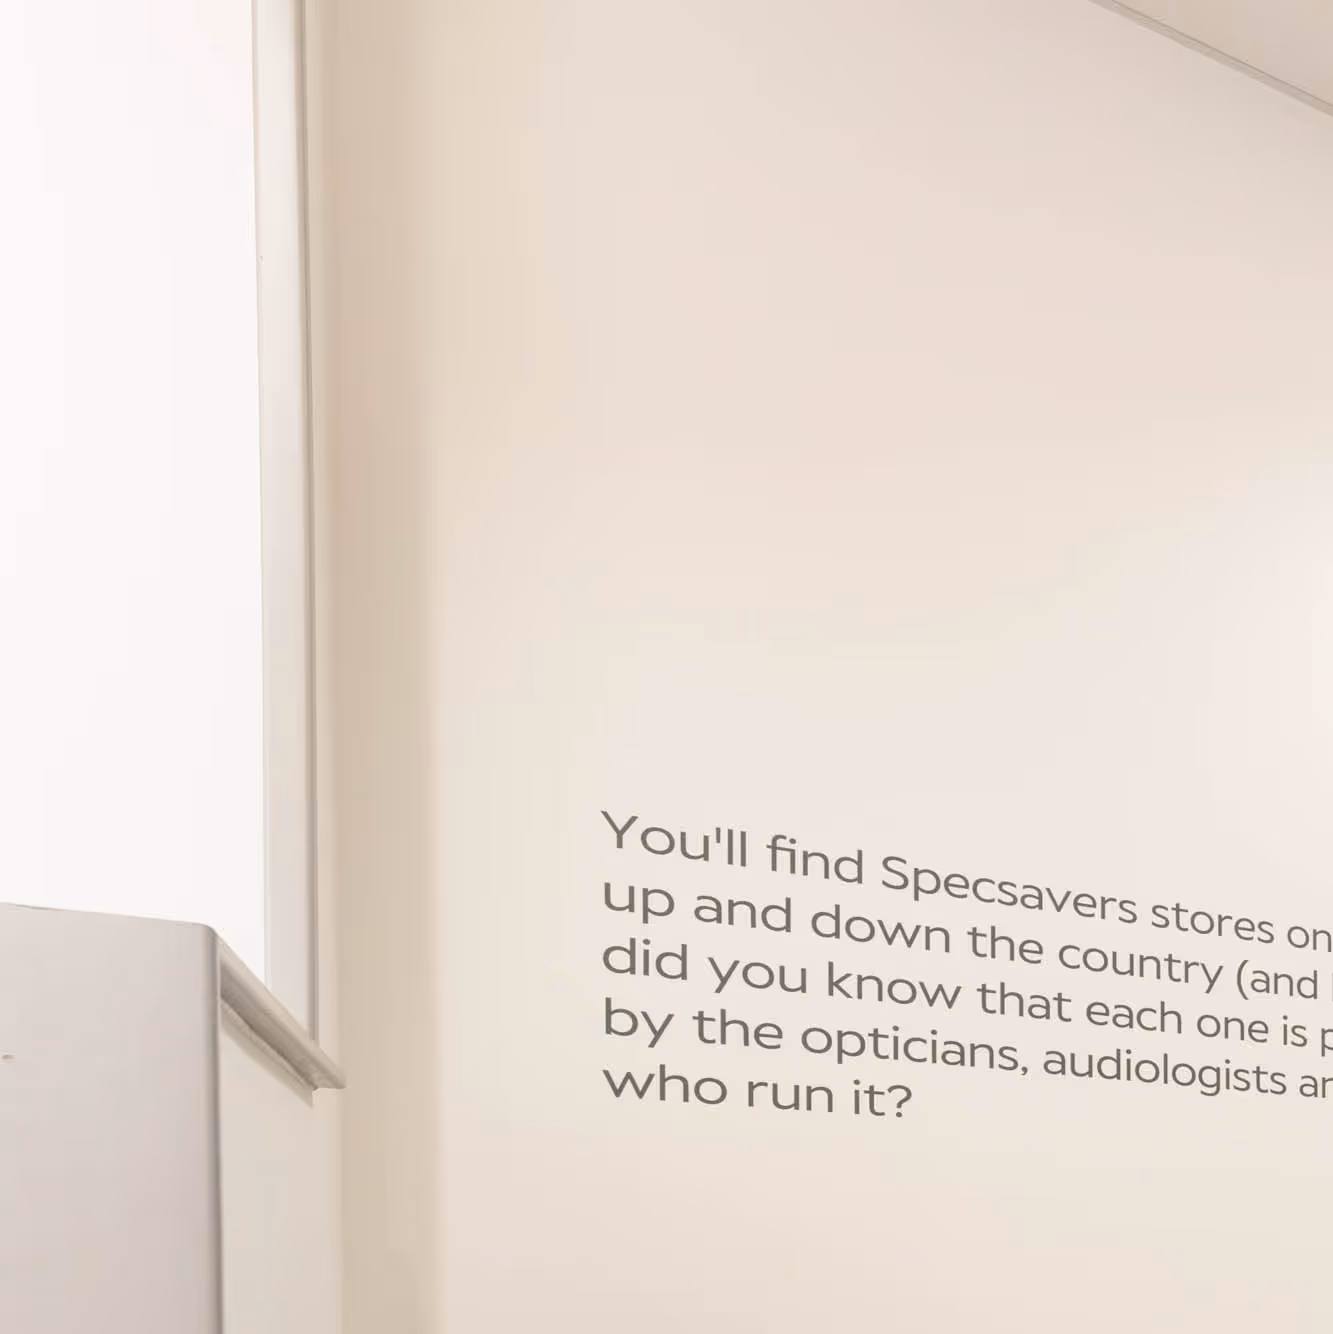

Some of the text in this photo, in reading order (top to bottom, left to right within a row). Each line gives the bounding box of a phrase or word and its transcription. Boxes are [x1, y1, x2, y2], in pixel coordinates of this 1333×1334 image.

[601, 811, 746, 867] You'll
[766, 835, 863, 884] find
[882, 856, 1137, 924] Specsavers
[1152, 903, 1274, 943] stores
[1287, 926, 1331, 952] on
[603, 938, 687, 980] did
[708, 957, 806, 993] you
[828, 961, 962, 1009] know
[976, 982, 1072, 1022] that
[1086, 1001, 1182, 1034] each
[1197, 1015, 1269, 1043] one
[1283, 1015, 1307, 1047] is
[604, 882, 675, 924] up
[694, 895, 791, 933] and
[811, 904, 950, 953] down
[967, 925, 1043, 964] the
[1059, 945, 1224, 994] country
[1237, 960, 1317, 1000] (and
[602, 1064, 912, 1118] who run it?
[605, 997, 674, 1048] by
[692, 1009, 783, 1049] the
[801, 1025, 1028, 1076] opticians,
[1043, 1048, 1287, 1096] audiologists
